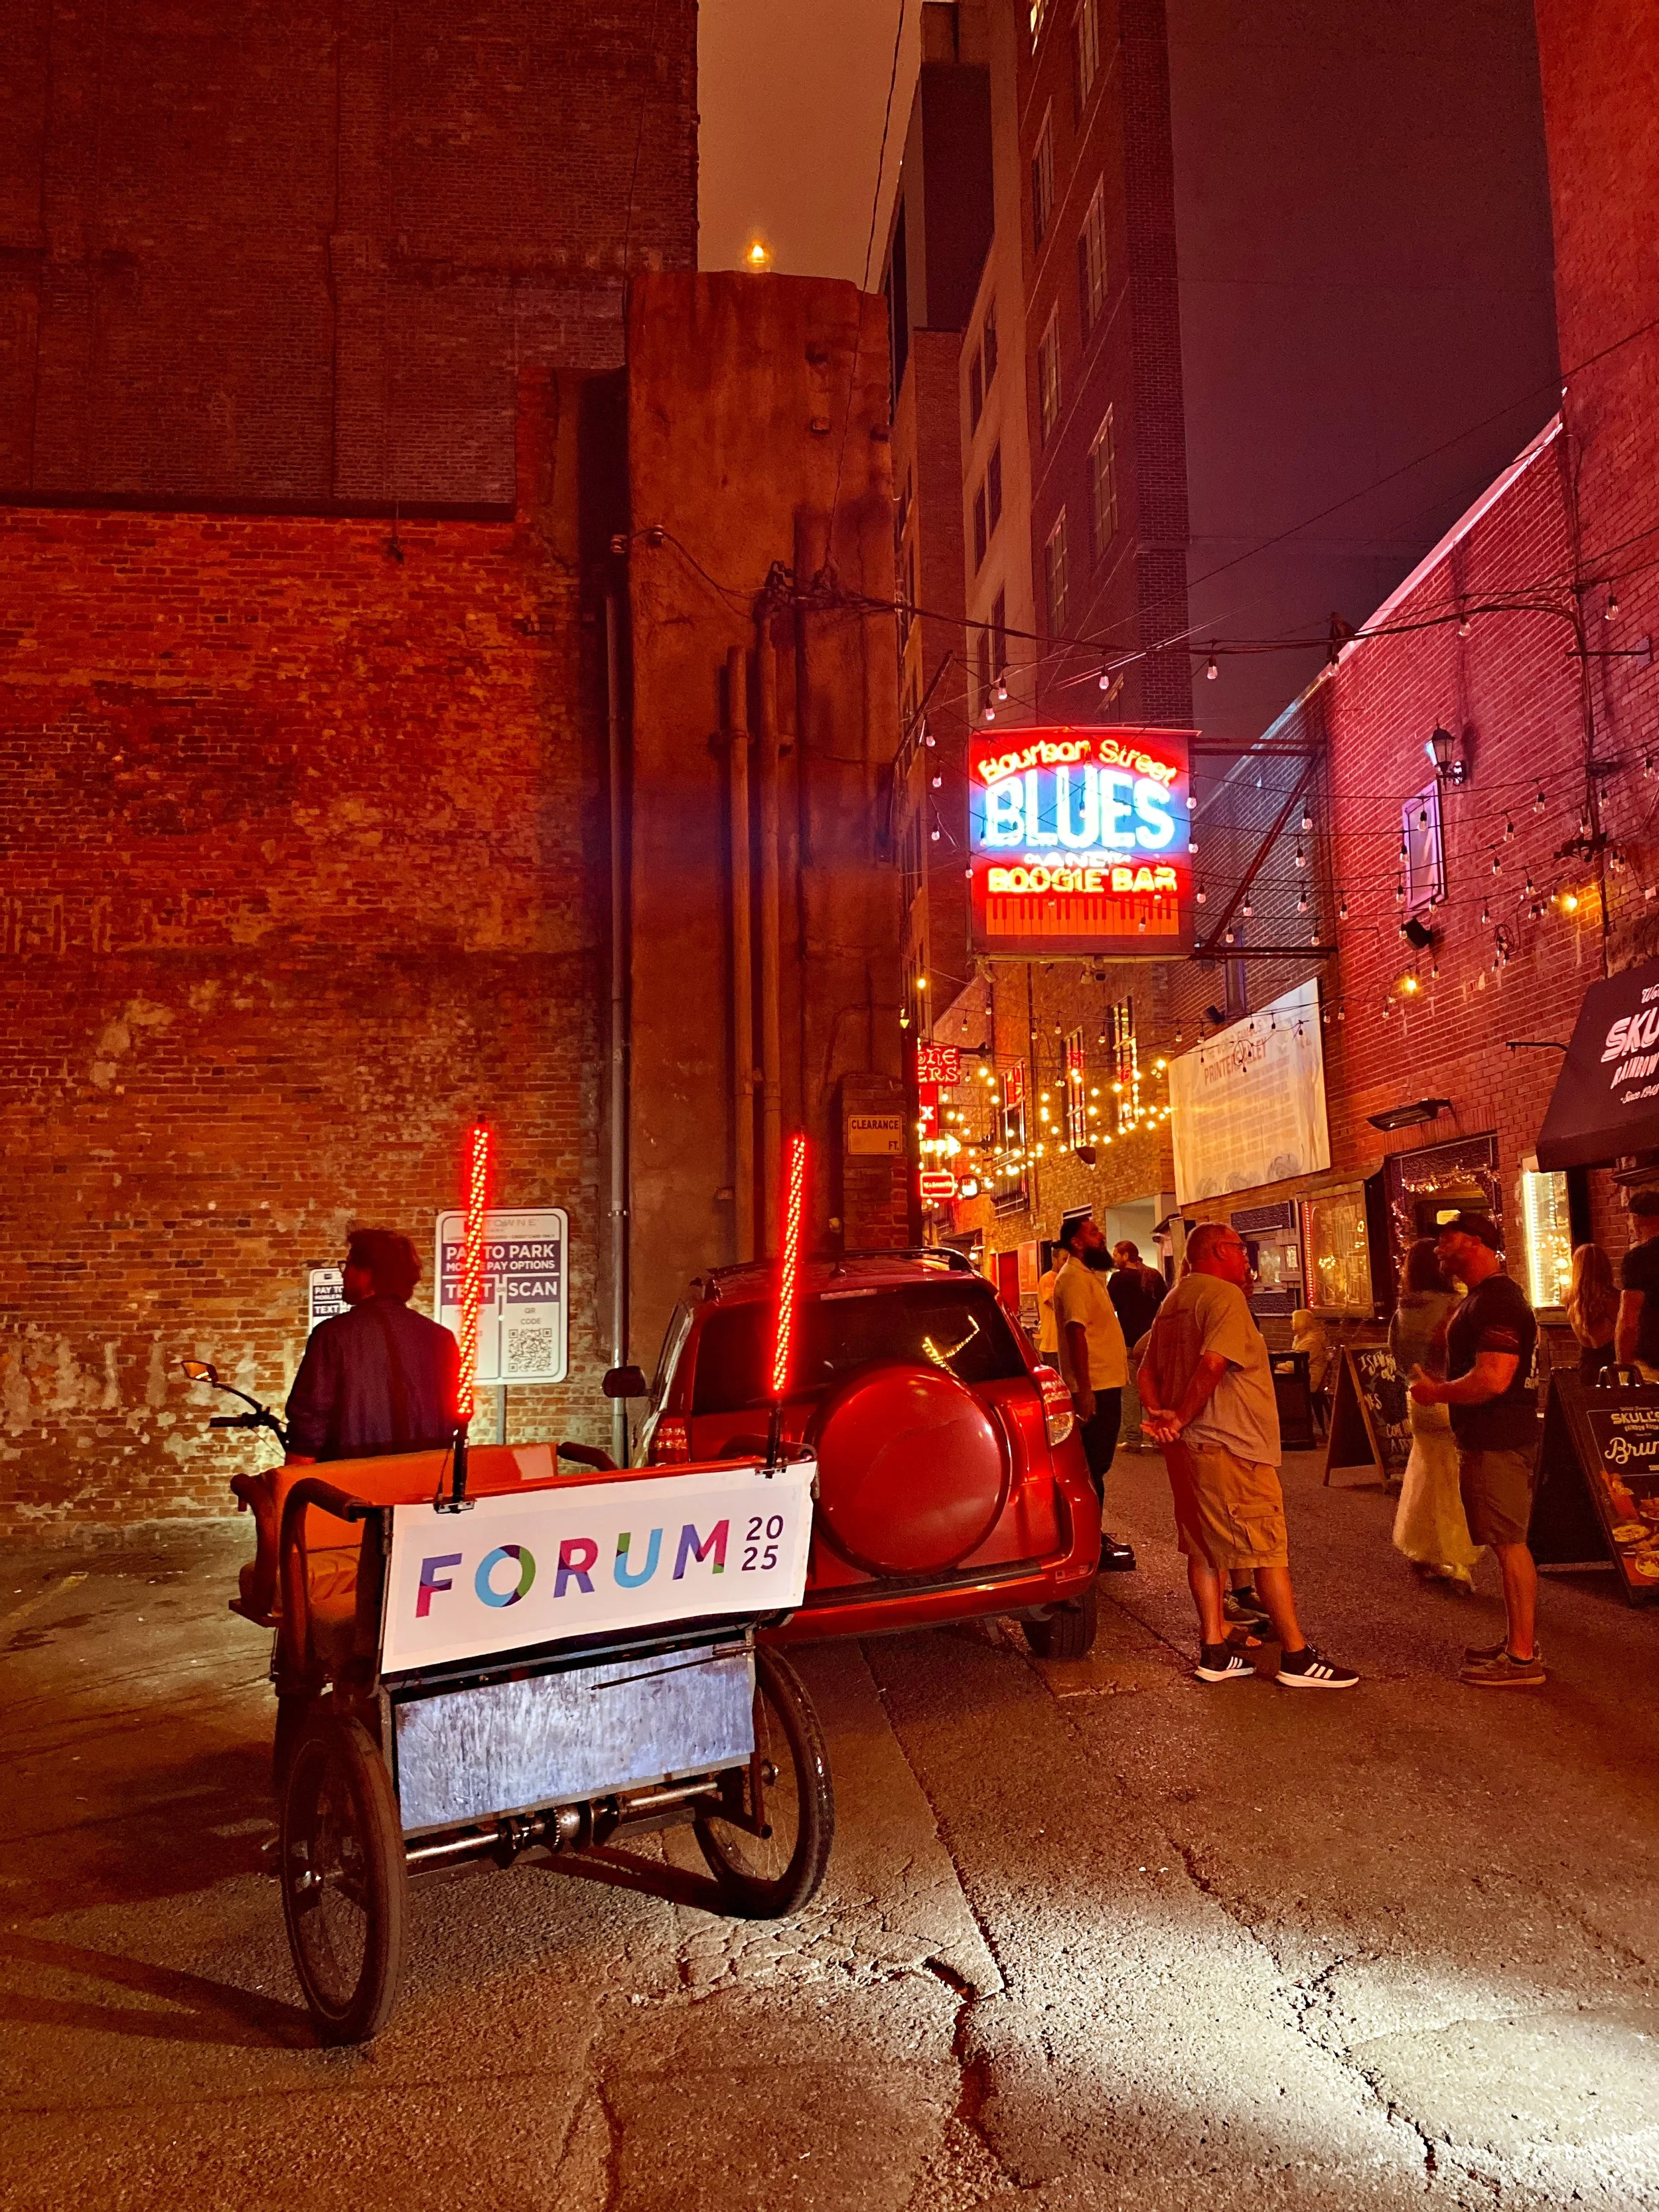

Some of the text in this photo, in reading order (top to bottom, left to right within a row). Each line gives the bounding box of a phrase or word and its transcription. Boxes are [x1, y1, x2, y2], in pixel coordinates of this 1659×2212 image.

[978, 739, 1177, 786] Bourbon Street
[985, 765, 1175, 849] BLUES
[1039, 851, 1109, 867] AND
[988, 867, 1178, 893] BOOGIE BAR
[851, 1120, 899, 1130] CLEARANCE
[888, 1141, 899, 1150] FT.
[446, 1244, 555, 1260] PA TO PARK
[446, 1260, 555, 1272] MOE PAY OPTIONS
[445, 1283, 492, 1299] TET
[508, 1281, 557, 1297] SCAN
[315, 1305, 339, 1314] TEXT
[746, 1514, 784, 1542] 20
[741, 1544, 779, 1572] 25
[416, 1518, 729, 1619] FORUM
